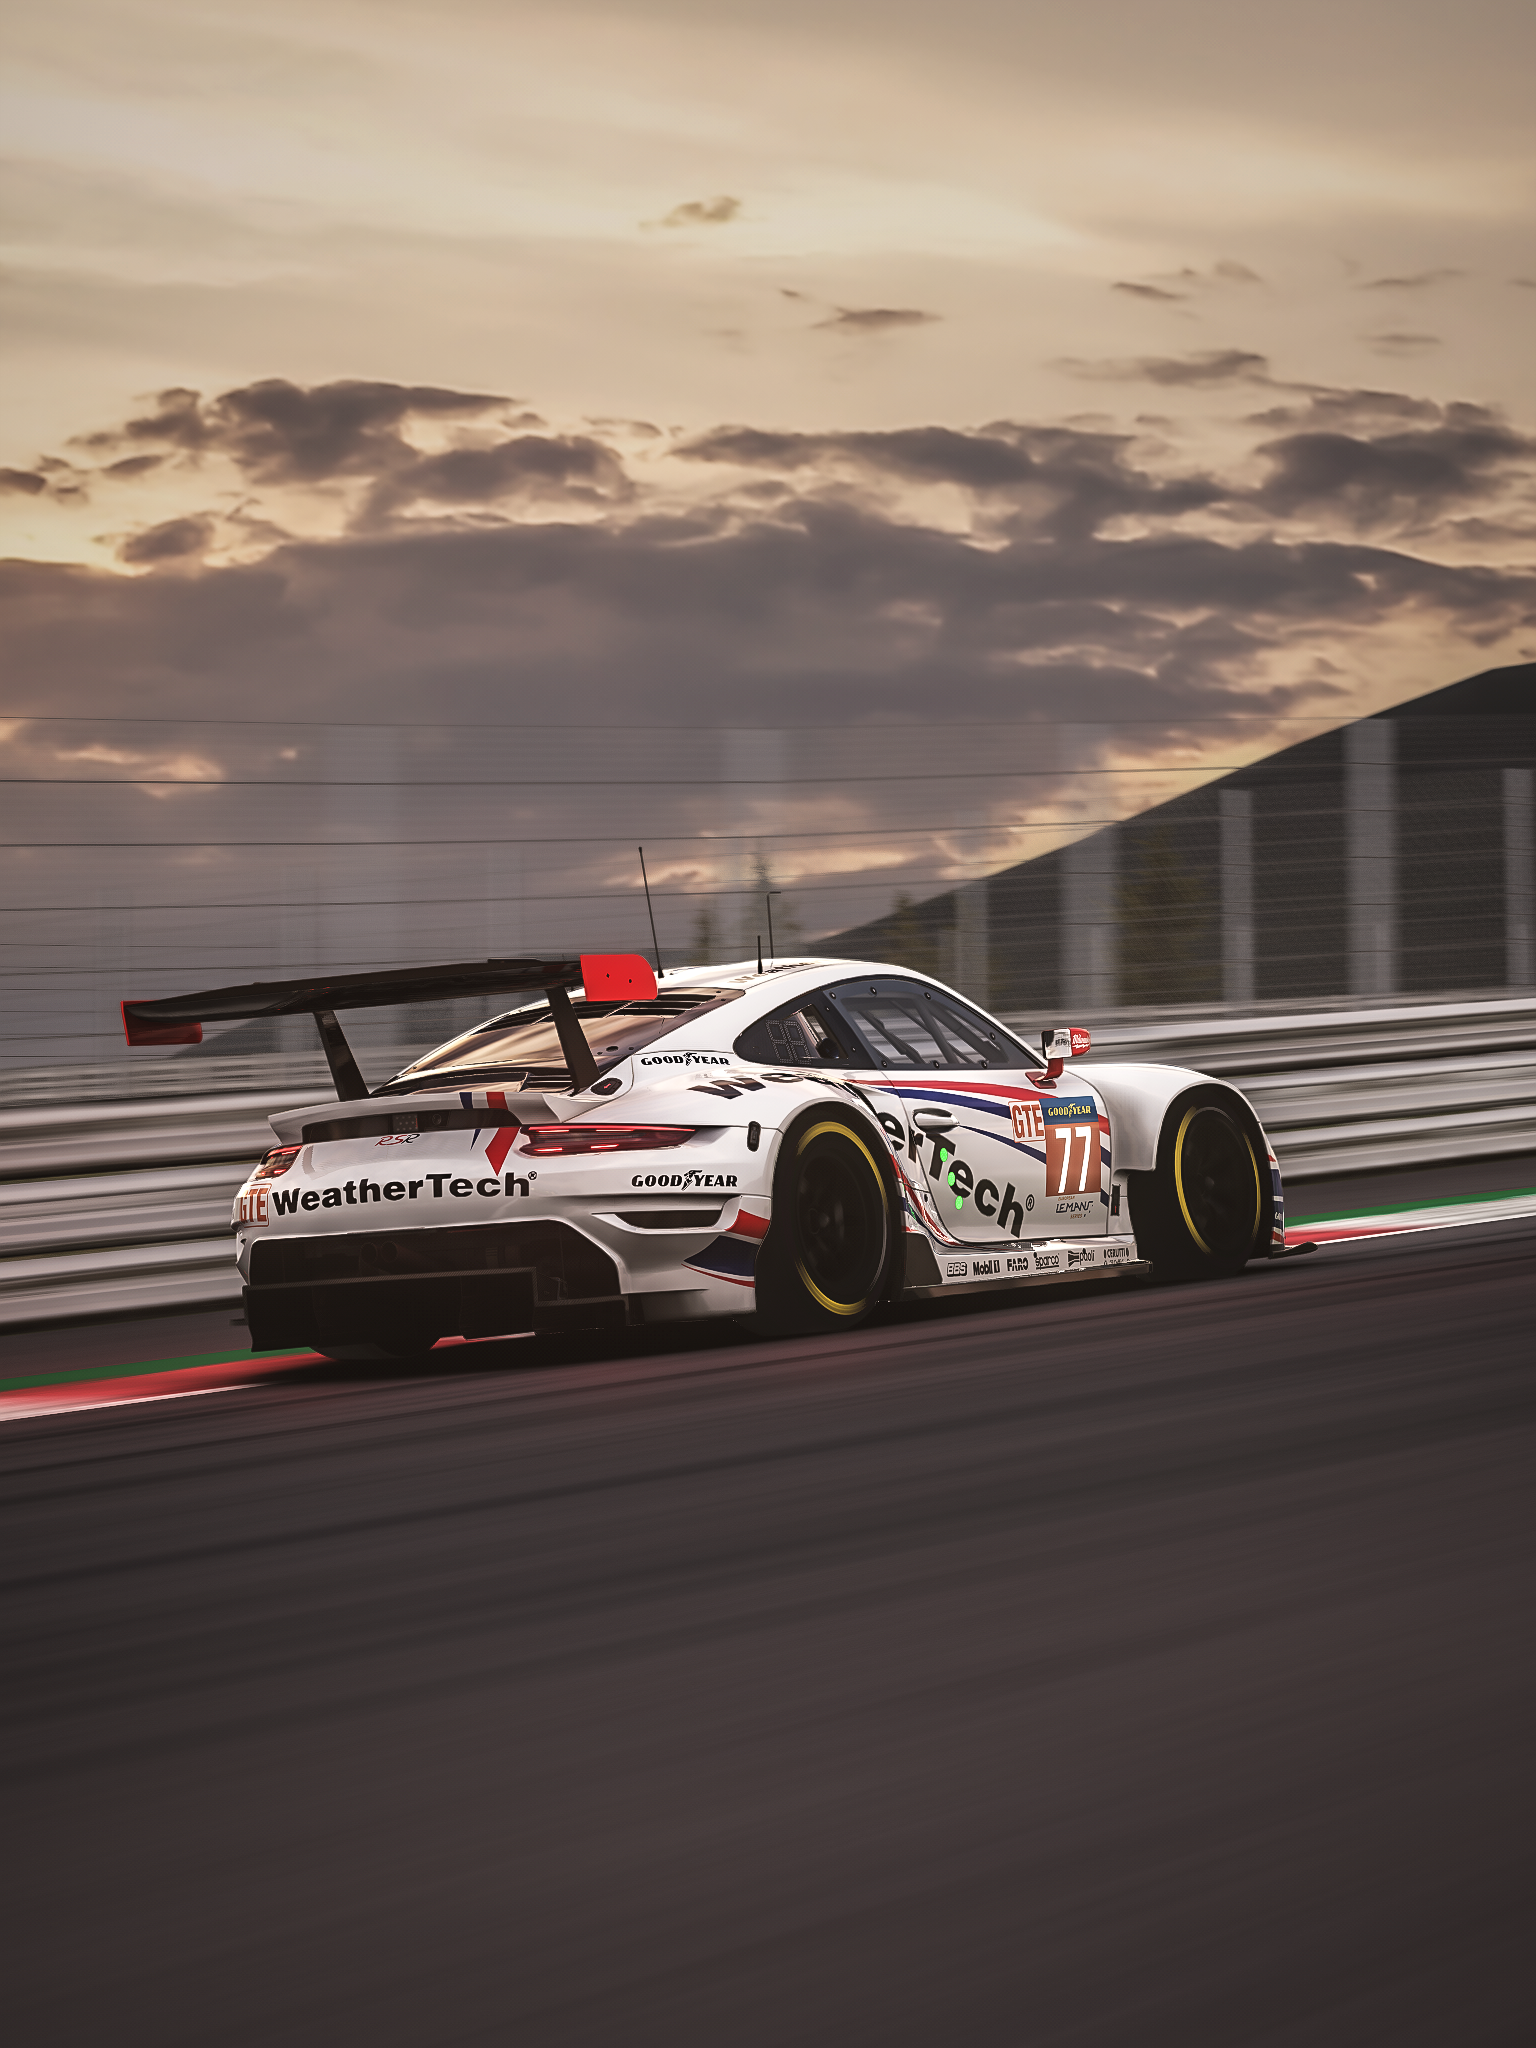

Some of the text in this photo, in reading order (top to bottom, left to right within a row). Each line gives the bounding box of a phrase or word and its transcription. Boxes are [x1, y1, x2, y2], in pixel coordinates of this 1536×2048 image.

[1012, 1104, 1044, 1138] GTE
[375, 1134, 420, 1146] RSR
[1055, 1126, 1091, 1193] 77
[241, 1188, 268, 1223] GTE
